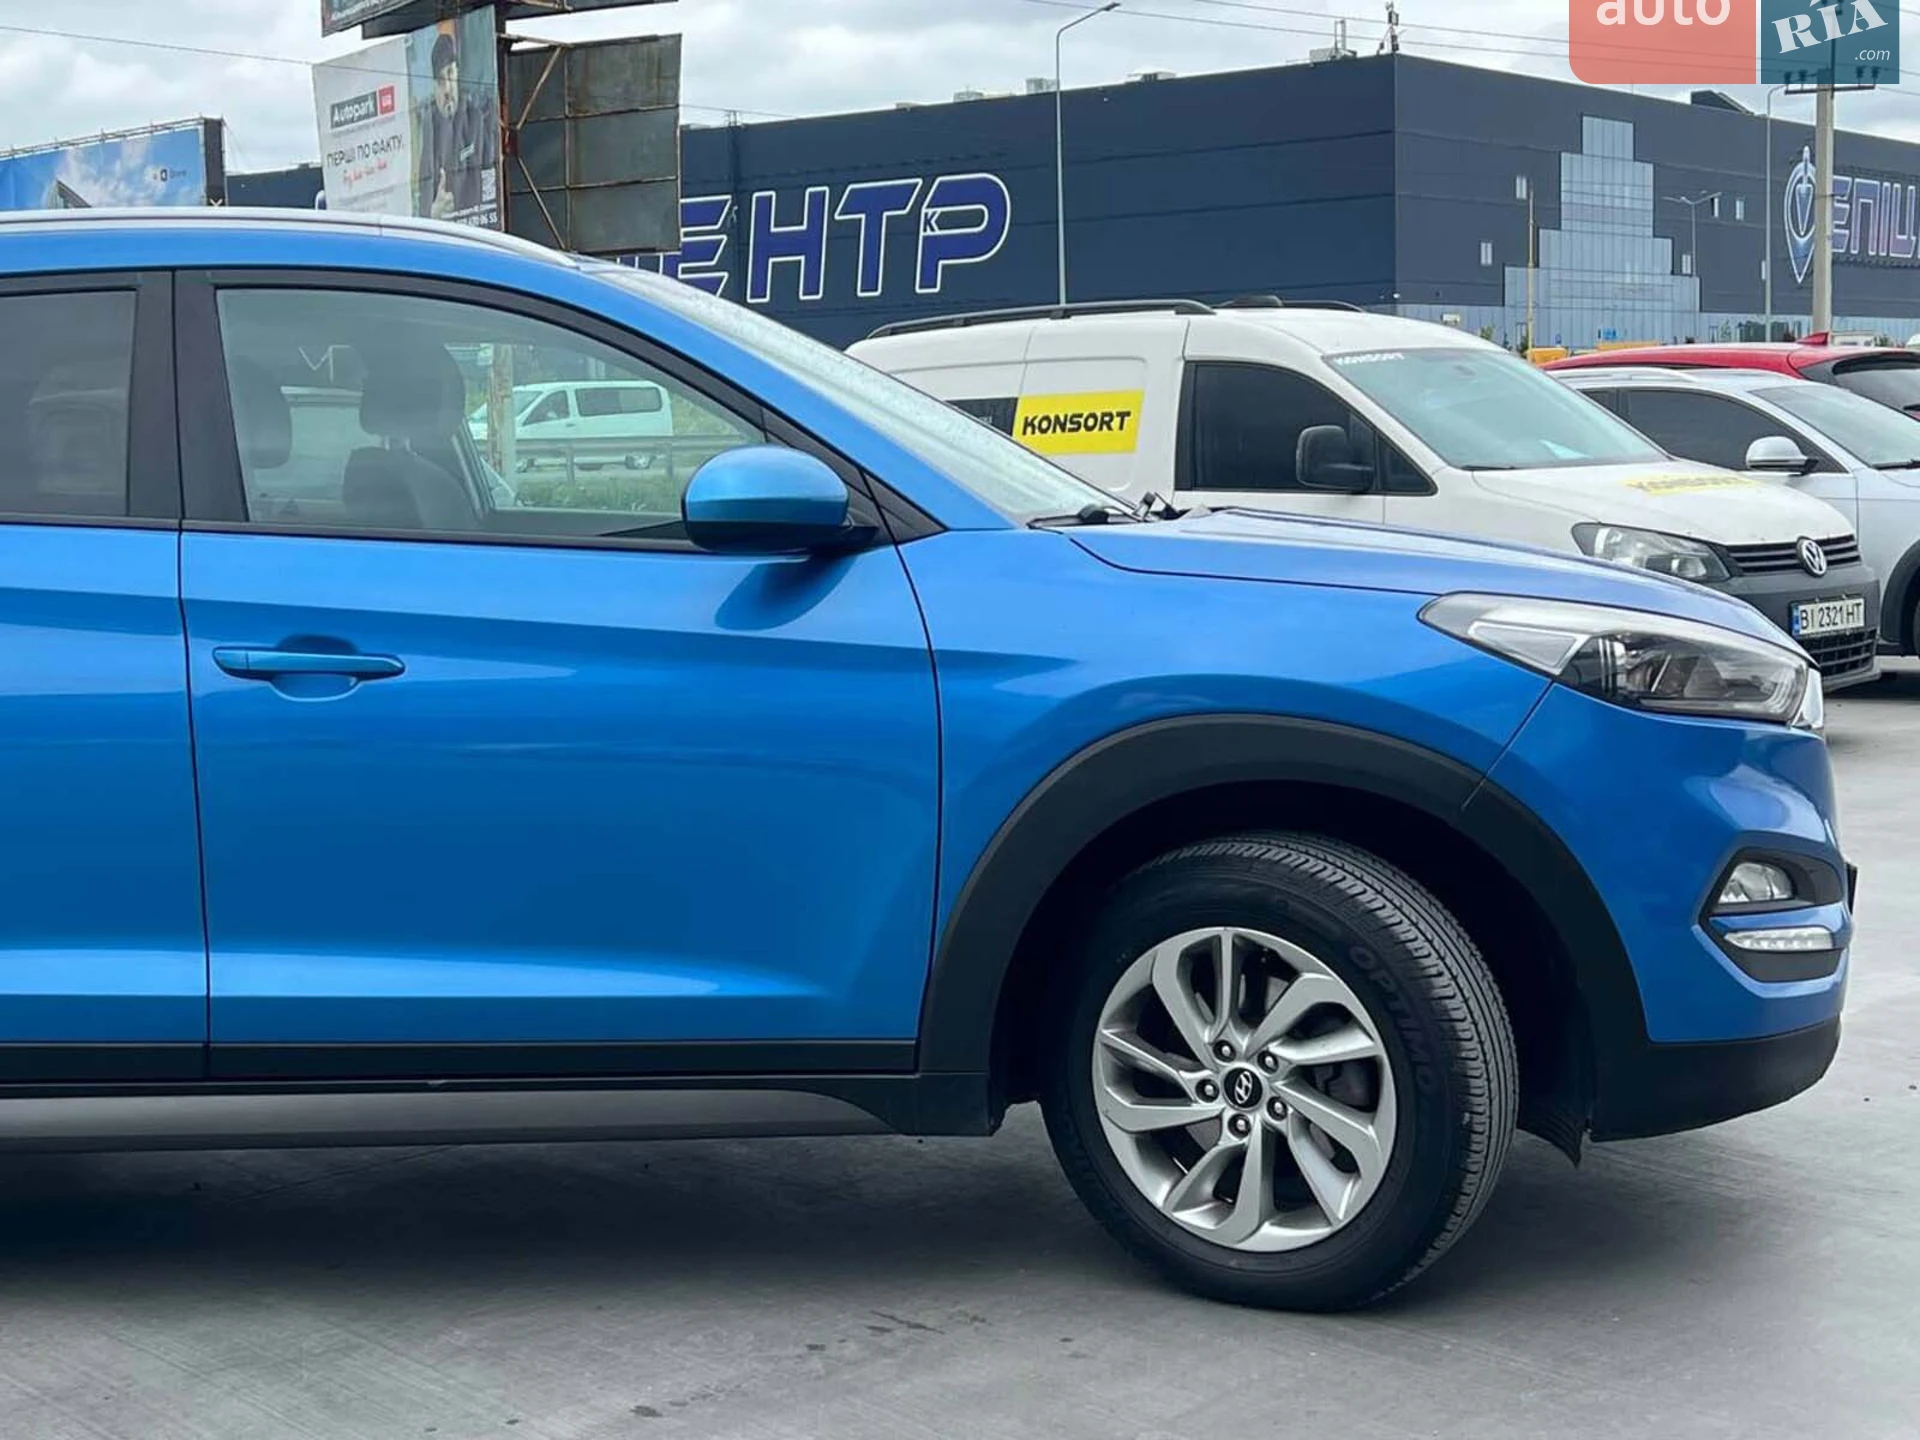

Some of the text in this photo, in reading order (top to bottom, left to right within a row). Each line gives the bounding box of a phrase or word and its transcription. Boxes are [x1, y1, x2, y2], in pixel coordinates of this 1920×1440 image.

[331, 93, 375, 124] Autopark
[1021, 410, 1132, 436] KONSORT
[1818, 605, 1844, 628] 2321
[1846, 602, 1863, 625] HT
